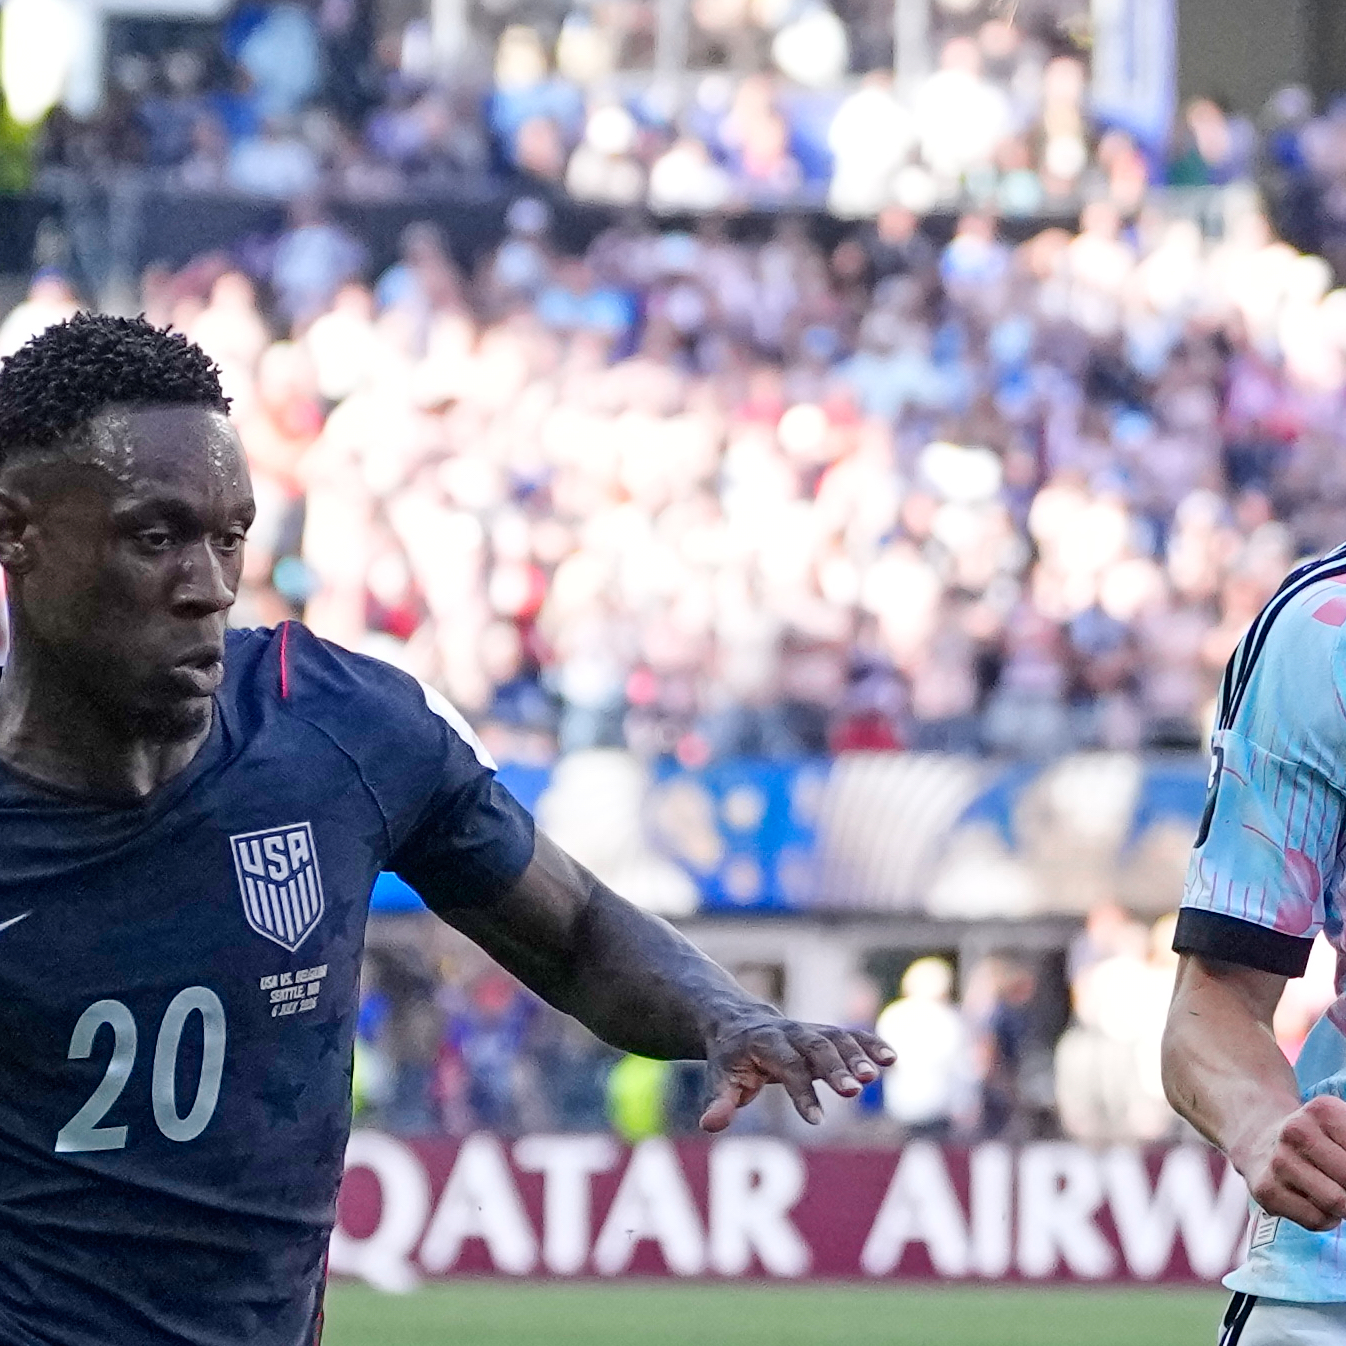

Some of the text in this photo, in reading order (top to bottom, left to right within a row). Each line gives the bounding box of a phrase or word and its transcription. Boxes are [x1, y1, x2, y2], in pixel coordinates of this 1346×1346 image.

[237, 830, 311, 882] USA
[55, 985, 227, 1153] 20
[328, 1129, 813, 1295] QATAR
